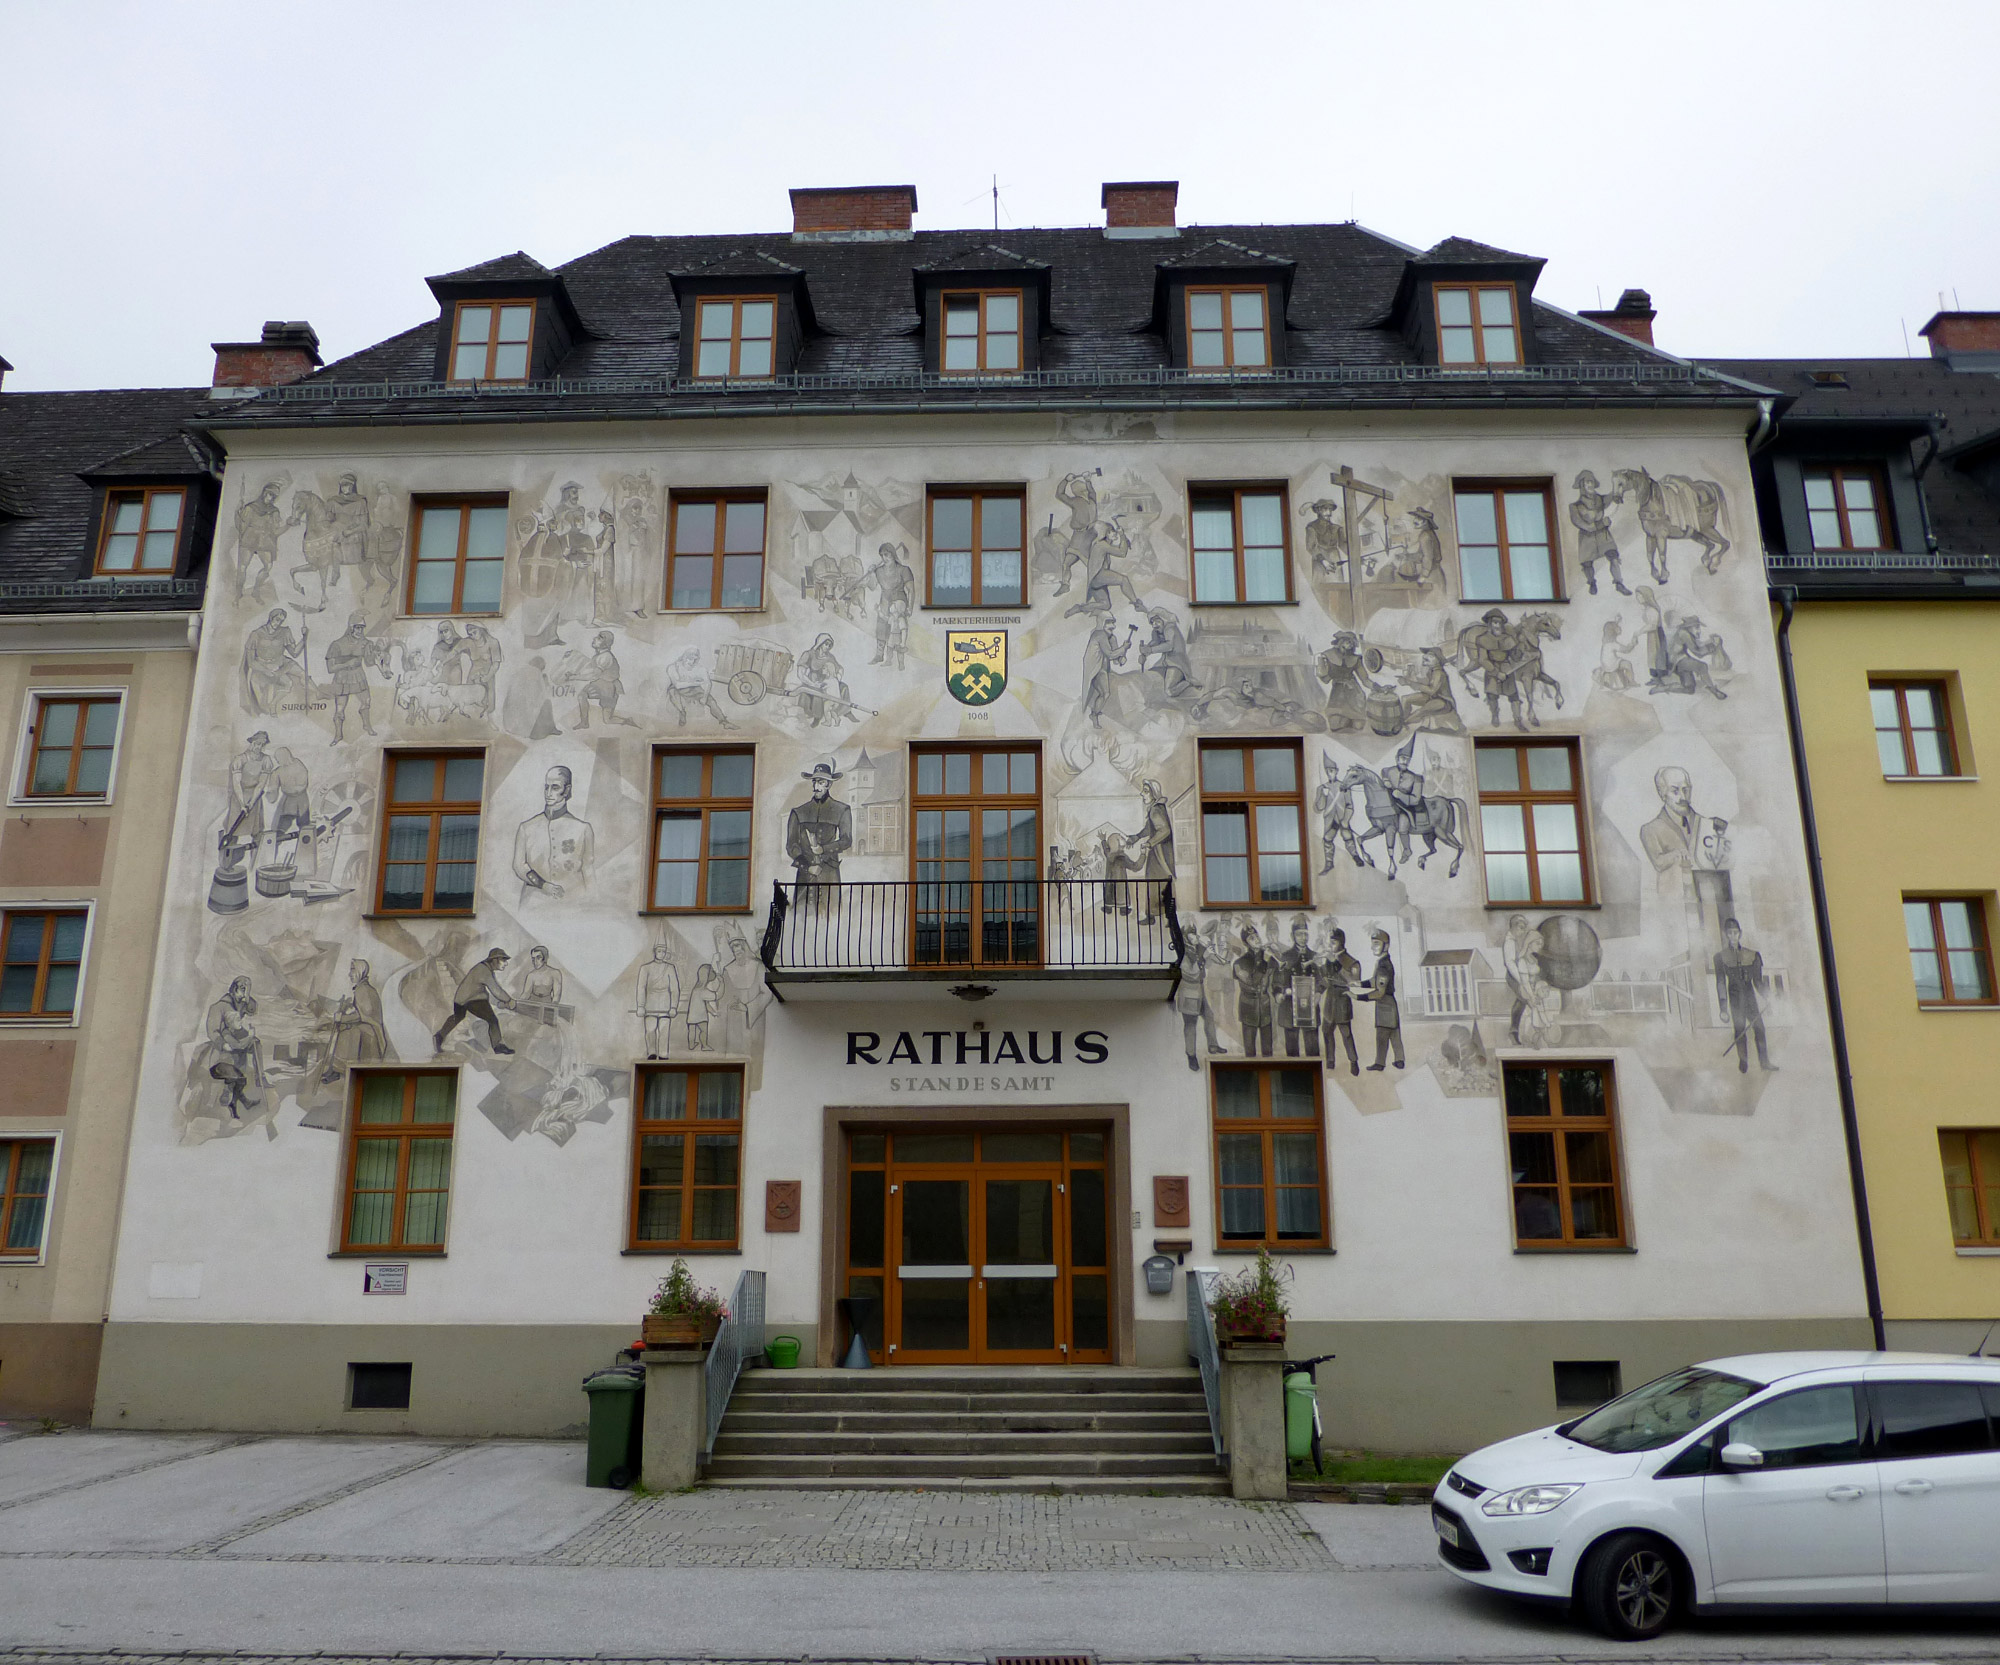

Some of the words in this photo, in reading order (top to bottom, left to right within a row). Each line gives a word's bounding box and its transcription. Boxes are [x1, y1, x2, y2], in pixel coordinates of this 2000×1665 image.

[932, 616, 1021, 625] MARKTERHEBUNG
[552, 685, 576, 697] 1074
[1703, 835, 1713, 848] C
[845, 1030, 1110, 1065] RATHAUS
[890, 1076, 1055, 1092] STANDESAMT
